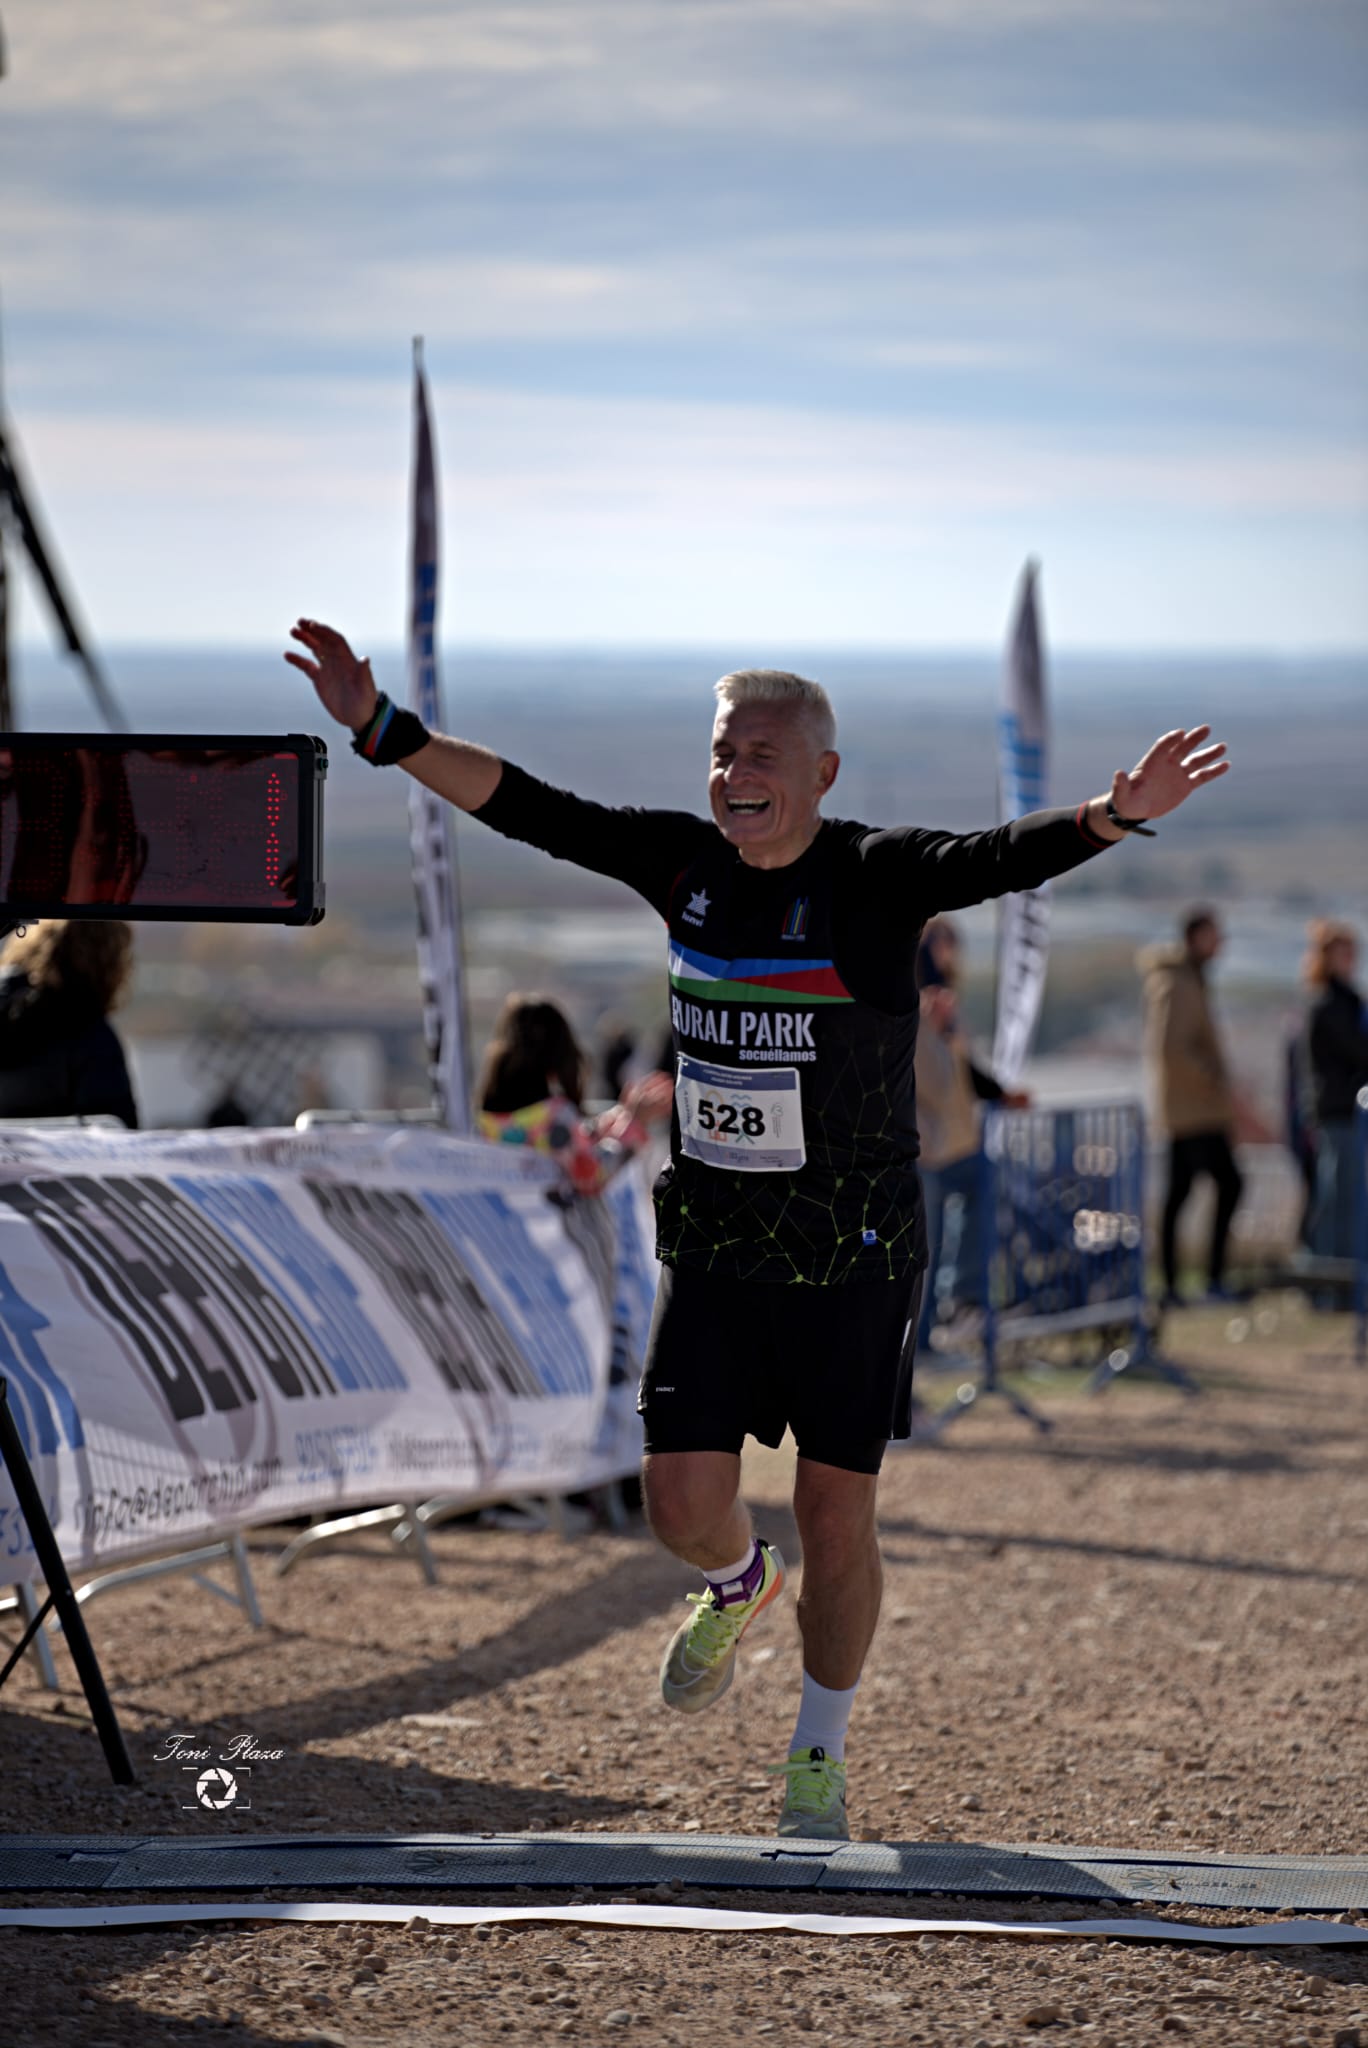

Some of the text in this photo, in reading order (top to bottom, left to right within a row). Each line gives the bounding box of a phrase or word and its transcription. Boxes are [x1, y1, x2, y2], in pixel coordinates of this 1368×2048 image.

[739, 1010, 817, 1048] PARK
[739, 1048, 818, 1063] socuéllamos
[697, 1098, 766, 1137] 528
